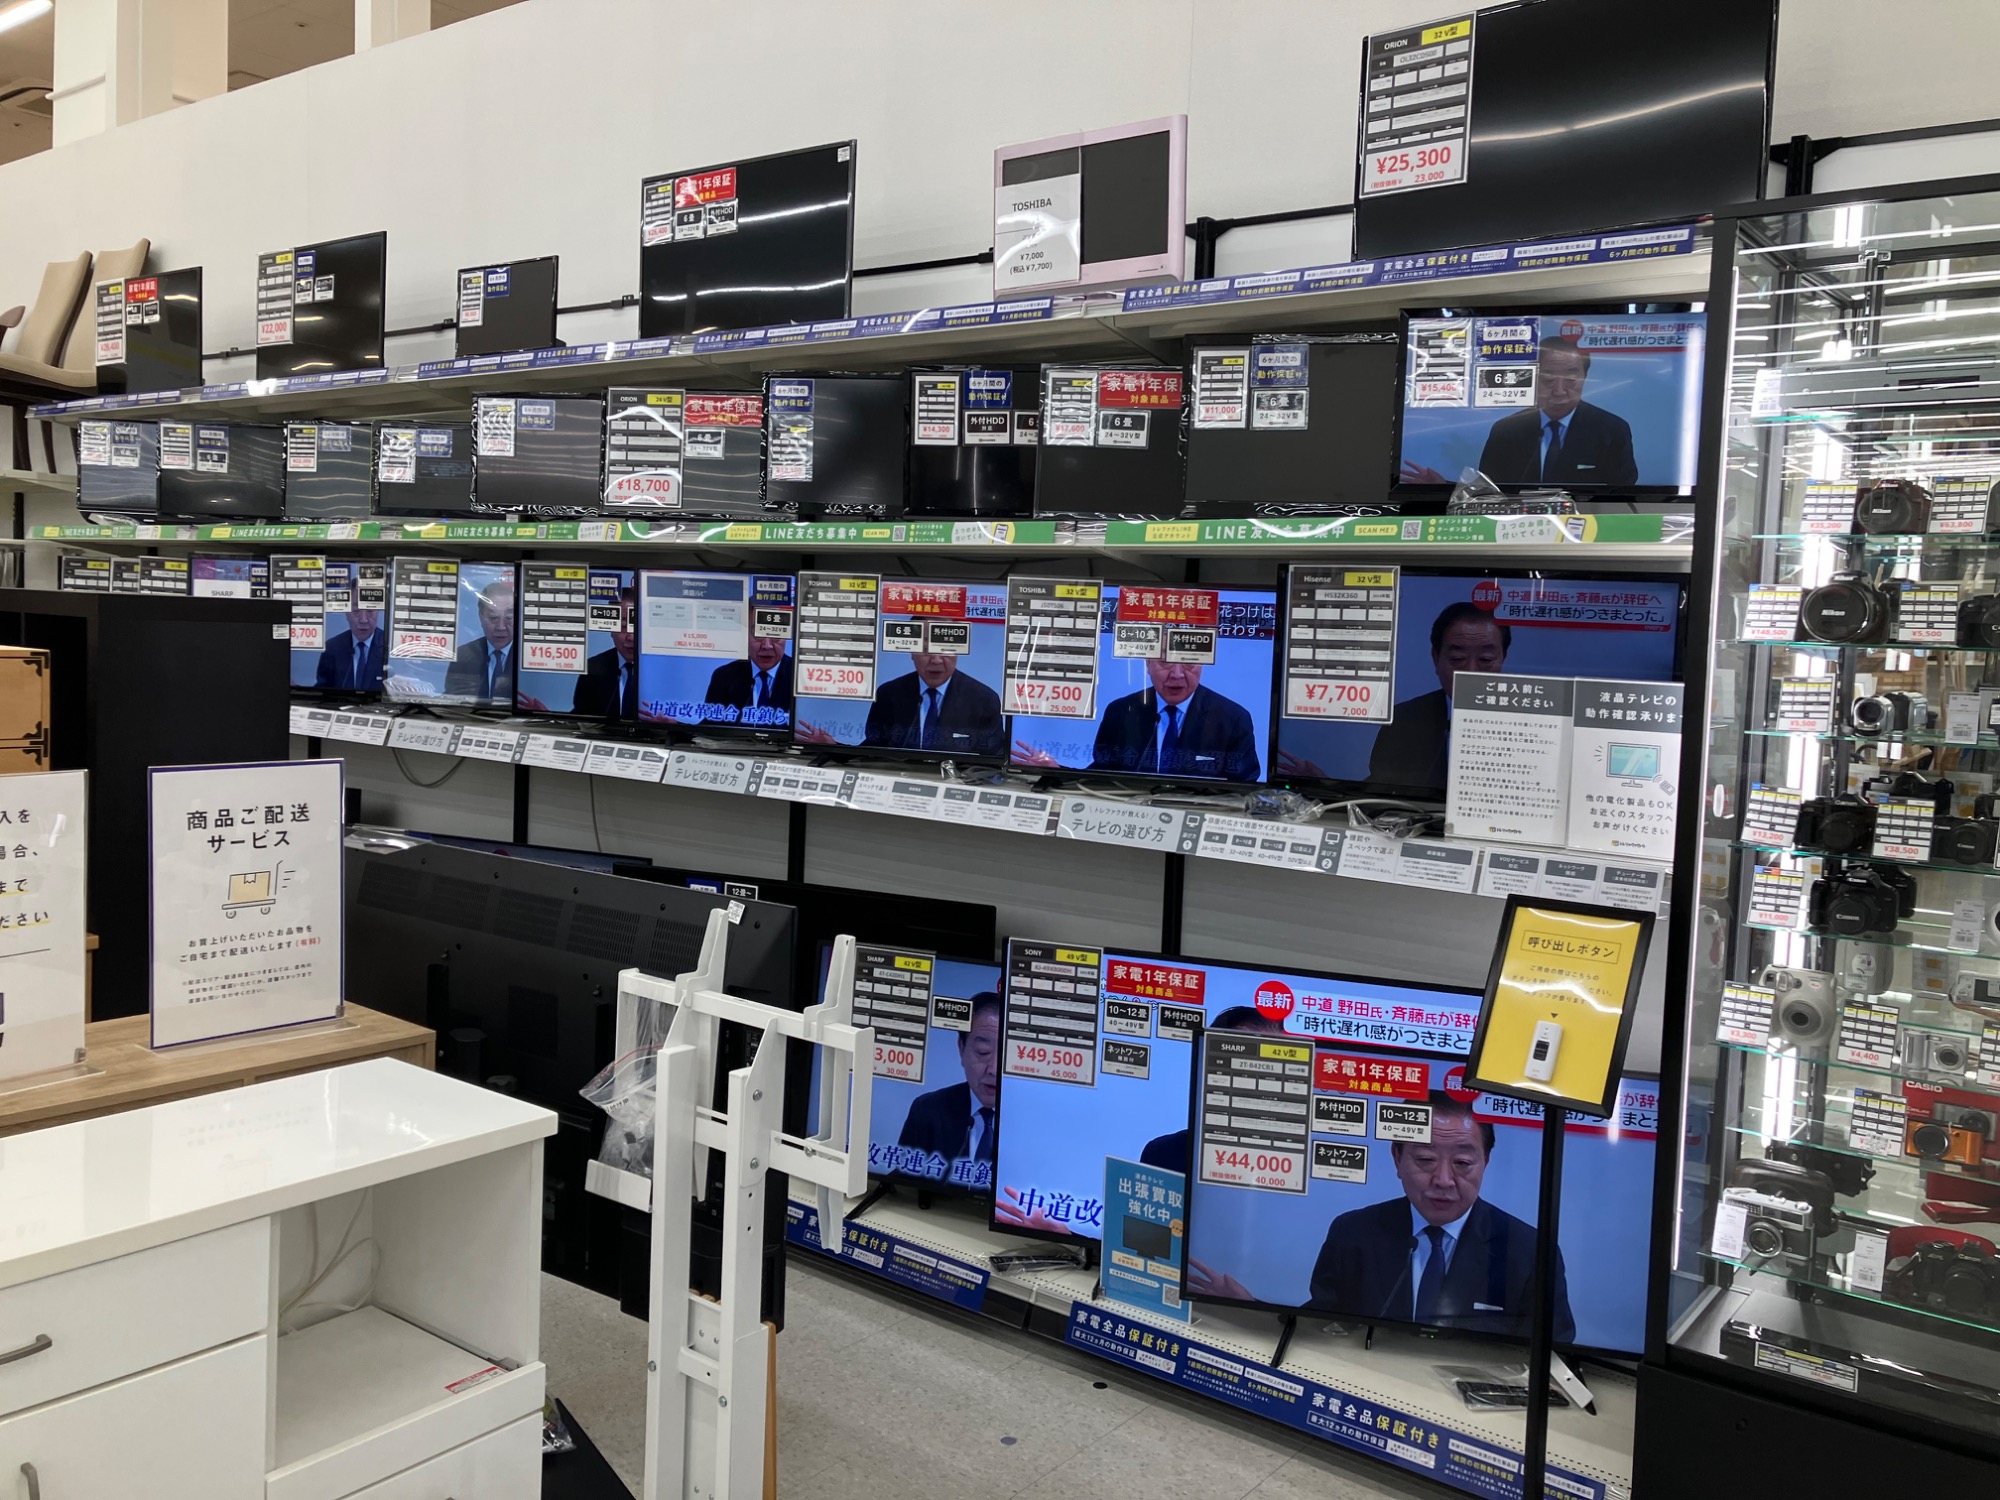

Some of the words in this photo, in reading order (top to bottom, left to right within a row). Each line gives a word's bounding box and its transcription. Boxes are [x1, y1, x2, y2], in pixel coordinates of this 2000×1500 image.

[1383, 39, 1408, 50] ORION
[1376, 146, 1452, 175] ¥25,300
[1414, 170, 1445, 184] 23,000
[1011, 197, 1053, 213] TOSHIBA
[1382, 252, 1468, 275] 家電全品保証付き
[261, 322, 288, 335] ¥22,000
[1106, 375, 1182, 393] 家電1年保
[1492, 372, 1515, 386] 6畳
[619, 395, 639, 404] ORION
[1129, 394, 1169, 404] 対象商品
[1204, 405, 1237, 415] ¥11,000
[970, 415, 1006, 426] 外付HDD
[1113, 416, 1133, 428] 6畳
[923, 425, 951, 434] ¥14,300
[616, 479, 671, 493] ¥18,700
[447, 526, 514, 538] LINE友だち募集中
[764, 526, 858, 540] LINE友だち募集中
[1357, 527, 1378, 535] SCAN
[1810, 521, 1842, 530] ¥35,200
[807, 580, 832, 590] TOSHIBA
[1303, 575, 1332, 586] Hisense
[888, 587, 962, 605] 家電1年保証
[1018, 586, 1047, 596] TOSHIBA
[1473, 589, 1500, 604] 最新
[1124, 592, 1213, 611] 家電1年保証
[1533, 591, 1662, 607] 野田氏・斉藤氏が辞任へ
[906, 602, 941, 614] 対象商品
[1501, 603, 1667, 624] 「時代遅れ感がつきまとった」
[1821, 608, 1846, 617] Nikon
[1147, 613, 1187, 624] 対象商品
[895, 625, 912, 637] 6畳
[933, 626, 966, 637] 外付HDD
[1217, 623, 1266, 638] 行わず。
[1912, 628, 1943, 638] ¥5,500
[1172, 633, 1210, 646] 外付HDD
[530, 646, 578, 661] ¥16,500
[806, 667, 865, 685] ¥25,300
[1015, 683, 1083, 702] ¥27,500
[1304, 683, 1371, 704] ¥7,700
[1485, 681, 1545, 695] ご購入前に
[1474, 694, 1554, 709] ご確認ください
[1600, 690, 1678, 707] 液晶テレビの
[649, 700, 740, 722] 中道改革連合
[1342, 707, 1368, 717] 7,000
[1585, 706, 1684, 725] 動作確認承りま
[674, 767, 740, 789] テレビの選び方
[1585, 794, 1675, 811] 他の電化製品もOK
[187, 802, 311, 831] 商品ご配送
[1589, 807, 1674, 823] お近くのスタッフへ
[1071, 817, 1168, 844] テレビの選び方
[1592, 821, 1670, 836] お声がけください
[206, 830, 290, 854] サービス
[1957, 841, 1976, 849] Canon
[1836, 912, 1861, 921] Canon
[187, 924, 314, 949] お買上げいただいたお品物を
[1024, 948, 1043, 958] SONY
[1527, 936, 1616, 958] 呼び出しボタン
[866, 955, 885, 965] SHARP
[1112, 967, 1200, 993] 家電1年保証
[1134, 984, 1174, 998] 対象商品
[937, 1001, 969, 1014] 外付HDD
[1255, 990, 1292, 1012] 最新
[1300, 993, 1333, 1014] 中道
[1163, 1010, 1201, 1023] 外付HDD
[1107, 1044, 1146, 1059] ネットワーク
[1220, 1043, 1247, 1053] SHARP
[1850, 1048, 1880, 1060] ¥4,400
[1016, 1044, 1084, 1068] ¥49,500
[885, 1067, 909, 1078] 30,000
[1050, 1069, 1078, 1081] 45,000
[1321, 1058, 1423, 1085] 家電1年保証
[1347, 1078, 1395, 1094] 対象商品
[1905, 1080, 1943, 1093] CASIO
[1318, 1101, 1362, 1115] 外付HDD
[1317, 1146, 1363, 1161] ネットワーク
[1214, 1149, 1293, 1175] ¥44,000
[1254, 1175, 1287, 1187] 40,000
[1118, 1177, 1183, 1209] 出張買取
[1017, 1187, 1103, 1228] 中道改
[1128, 1198, 1171, 1223] 強化中
[1075, 1308, 1181, 1359] 家電全品保証付き
[1246, 1380, 1297, 1405] 6ヶ月間の動作保証
[1311, 1390, 1441, 1449] 家電全品保証付き
[1448, 1452, 1515, 1484] 1週間の初期動作保証
